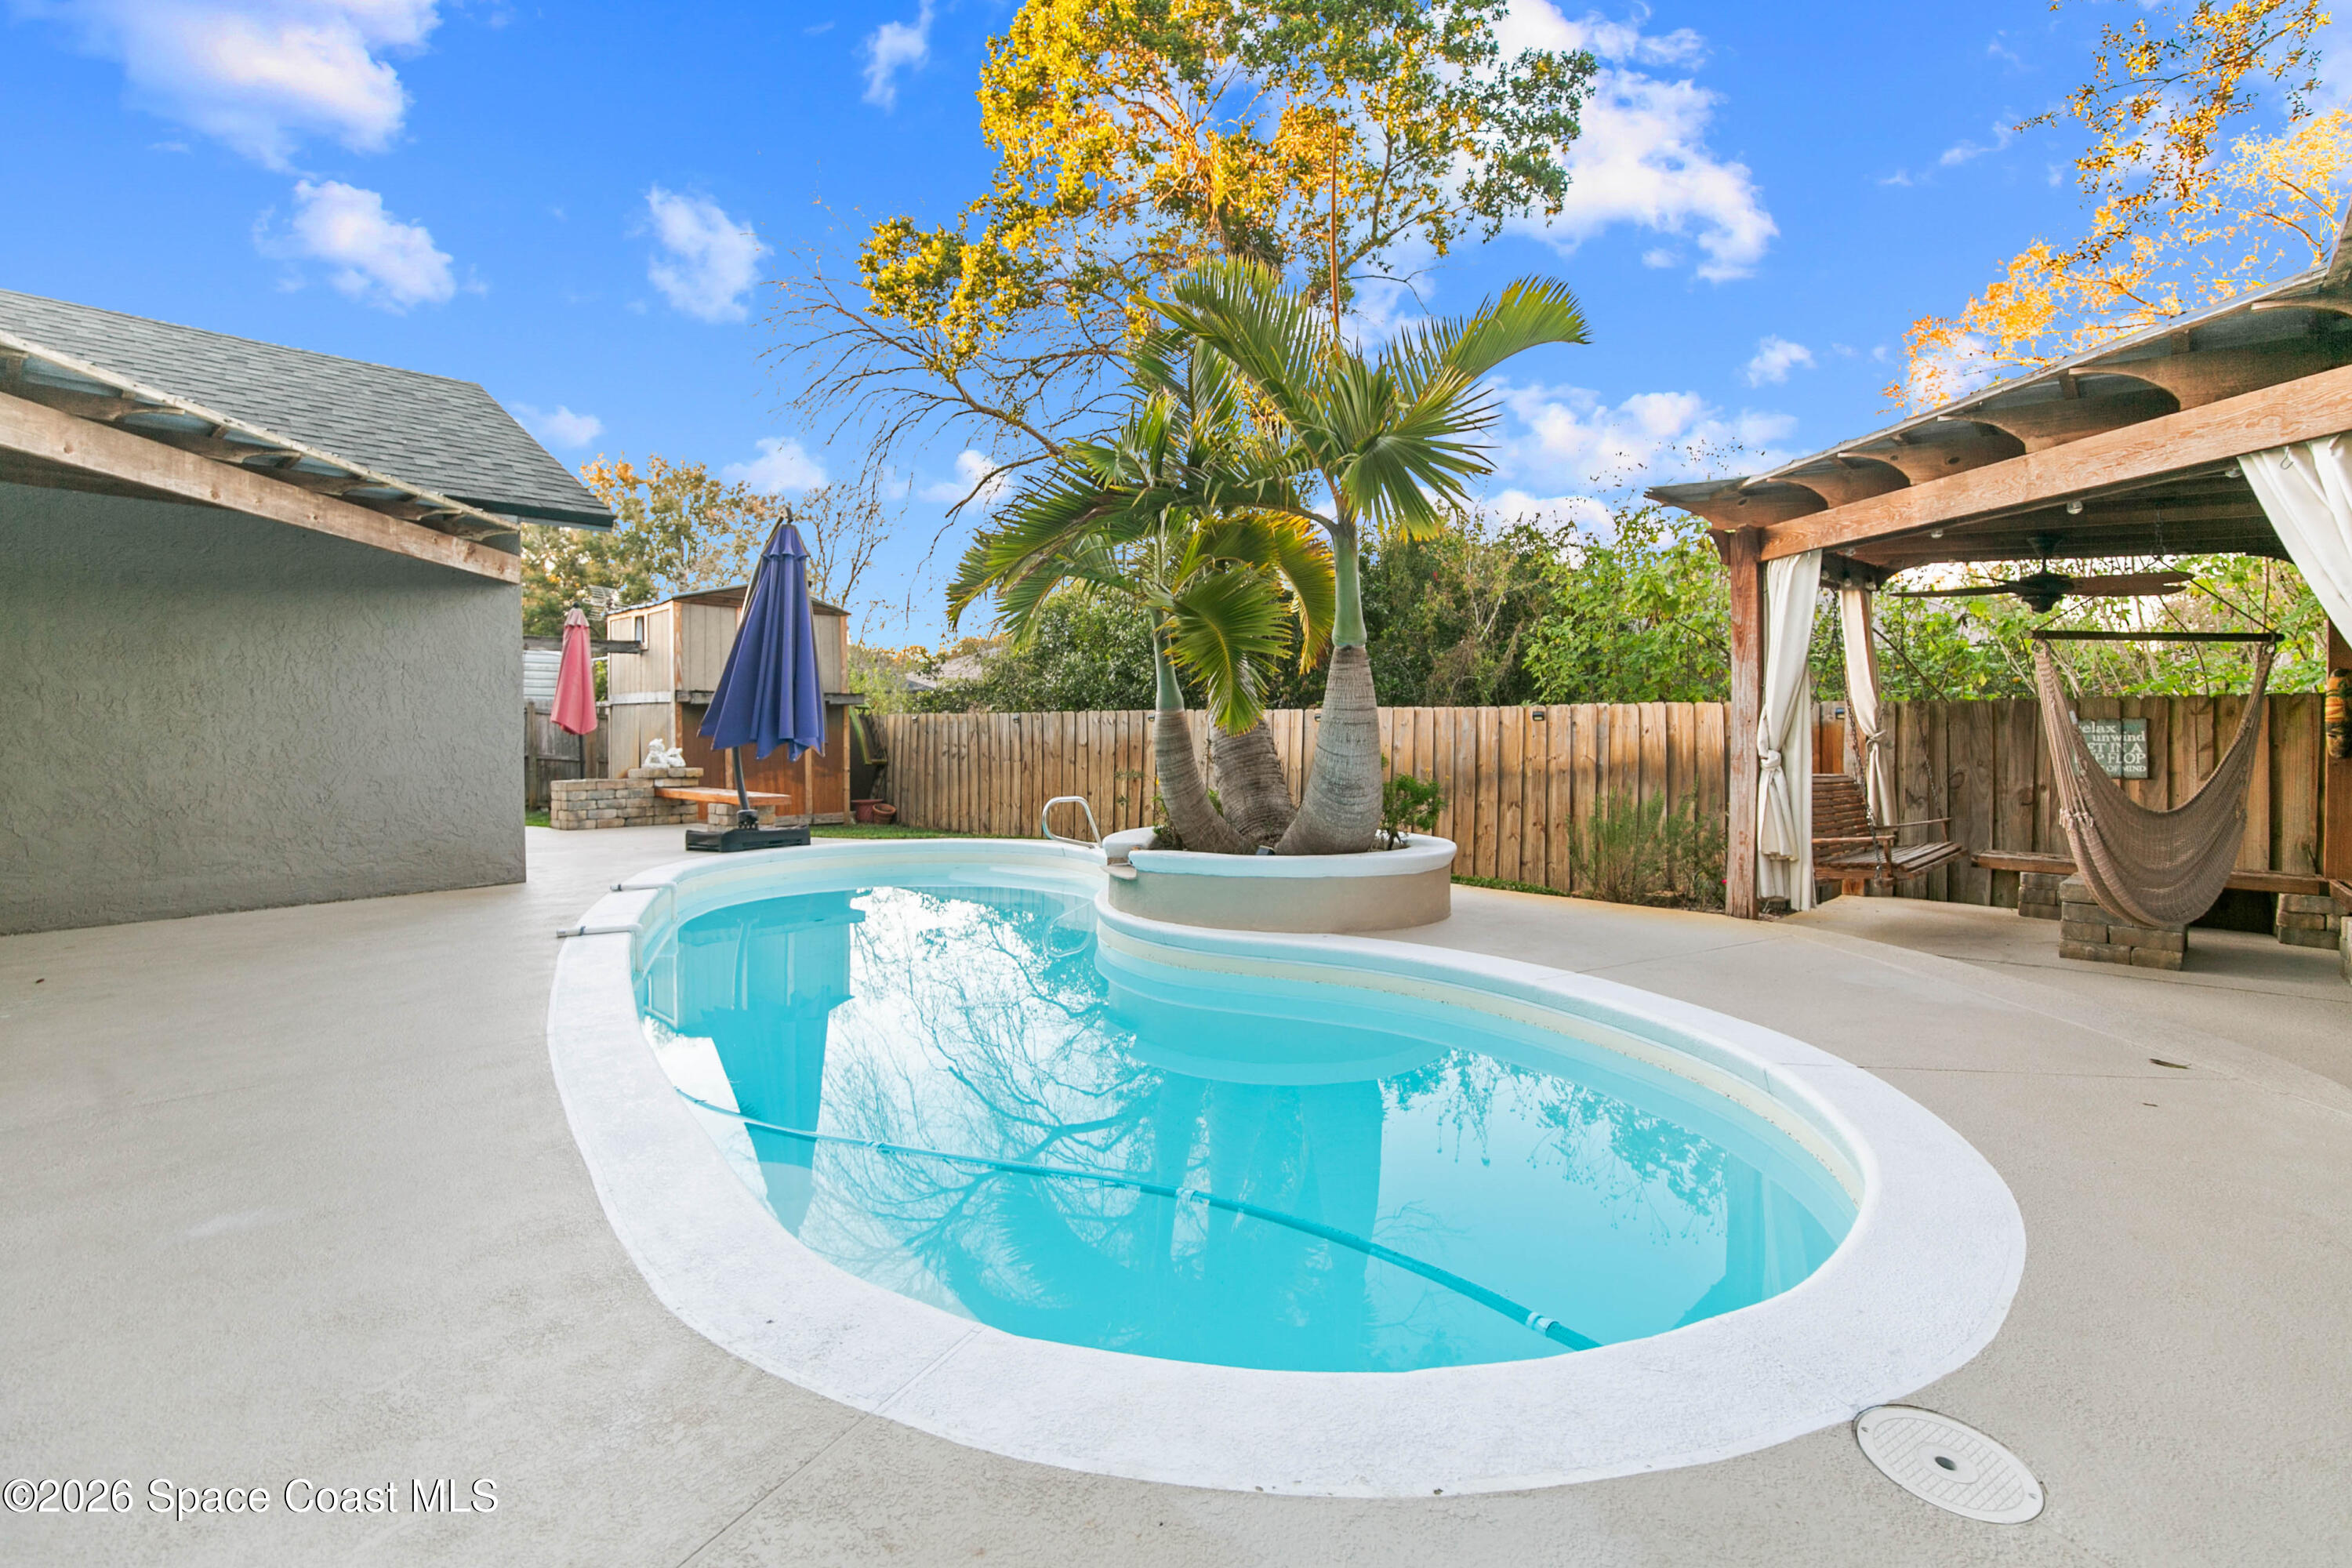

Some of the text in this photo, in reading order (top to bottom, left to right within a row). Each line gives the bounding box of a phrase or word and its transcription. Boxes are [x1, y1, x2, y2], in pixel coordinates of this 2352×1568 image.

[2078, 720, 2117, 733] elax
[2092, 731, 2146, 742] unwind
[2086, 742, 2143, 753] ET IN A
[2107, 753, 2147, 764] FLOP
